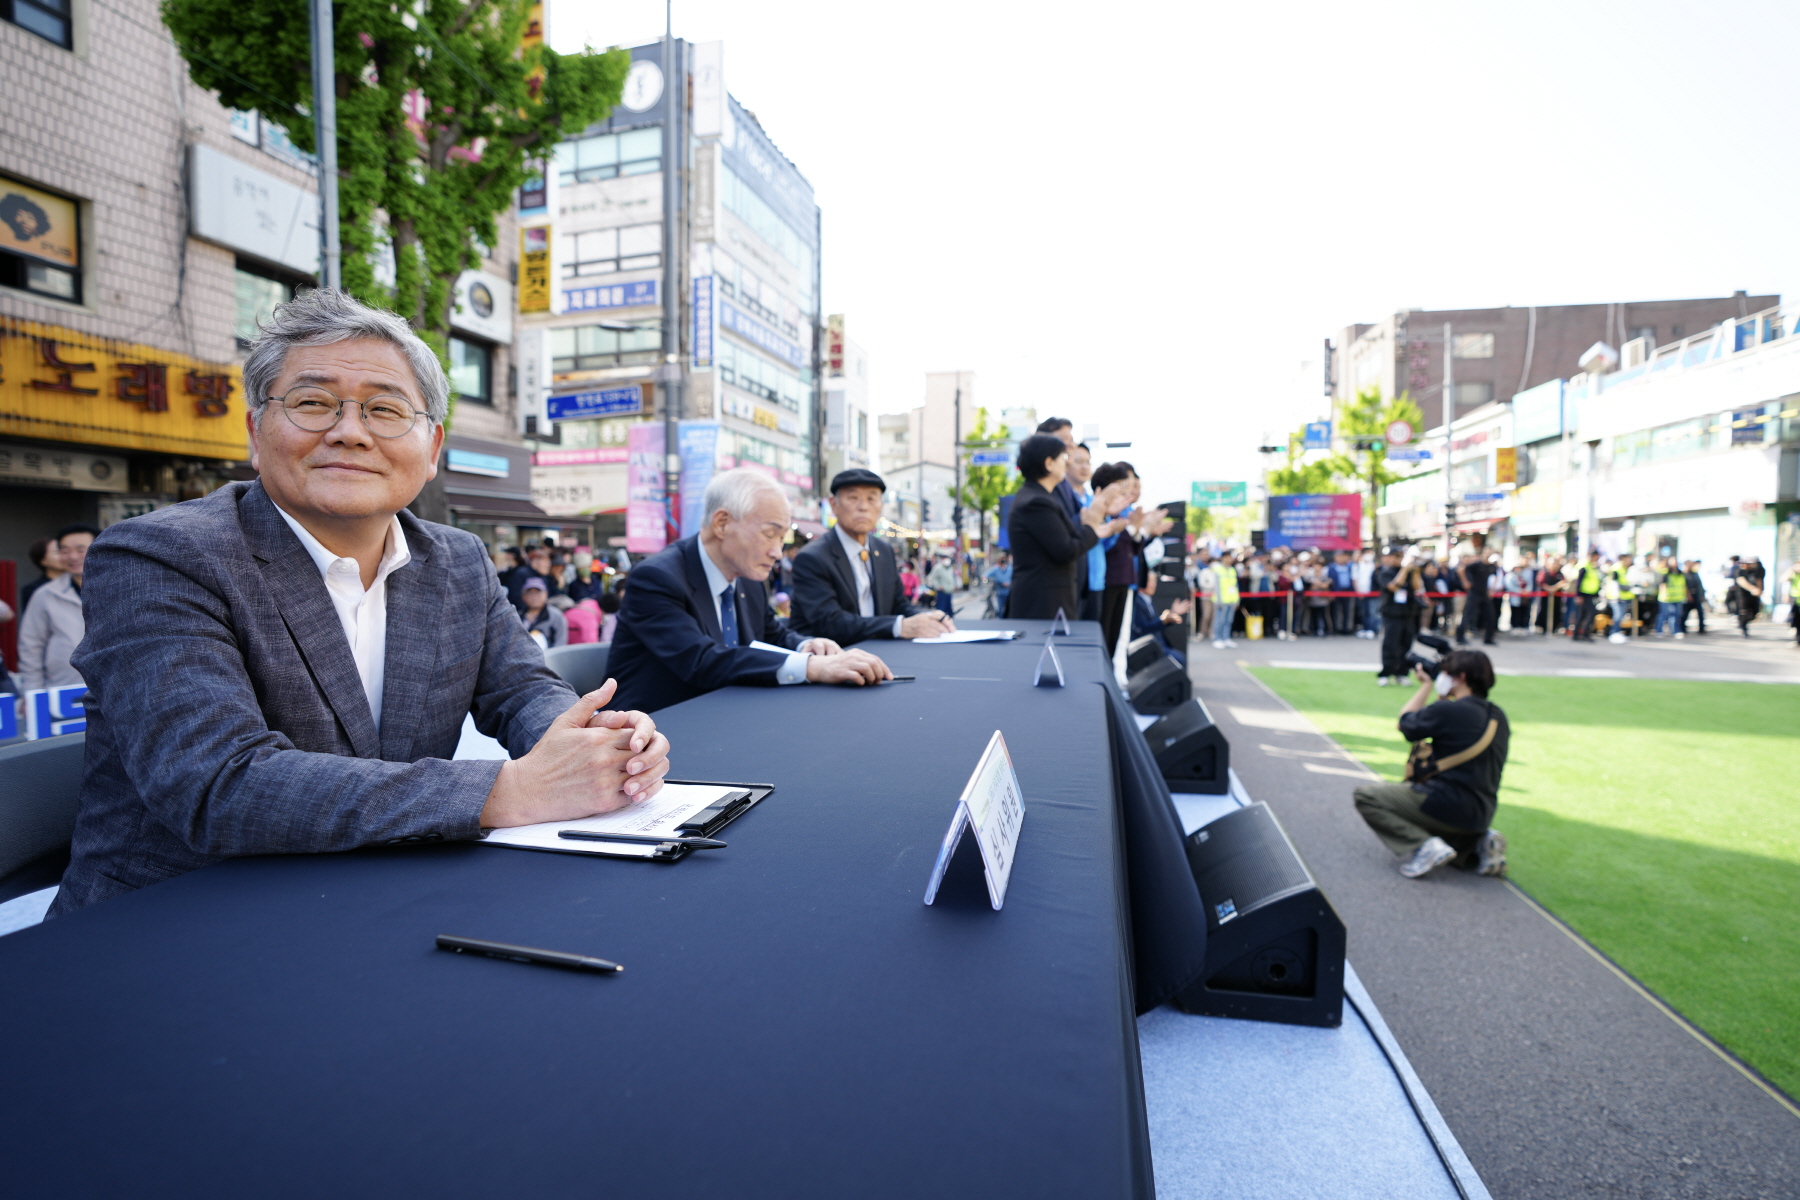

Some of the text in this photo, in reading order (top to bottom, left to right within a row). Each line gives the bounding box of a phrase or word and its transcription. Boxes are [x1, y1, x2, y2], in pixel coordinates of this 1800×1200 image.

[41, 241, 72, 258] PUB
[31, 338, 234, 417] 노래방
[991, 783, 1019, 871] 심사위원
